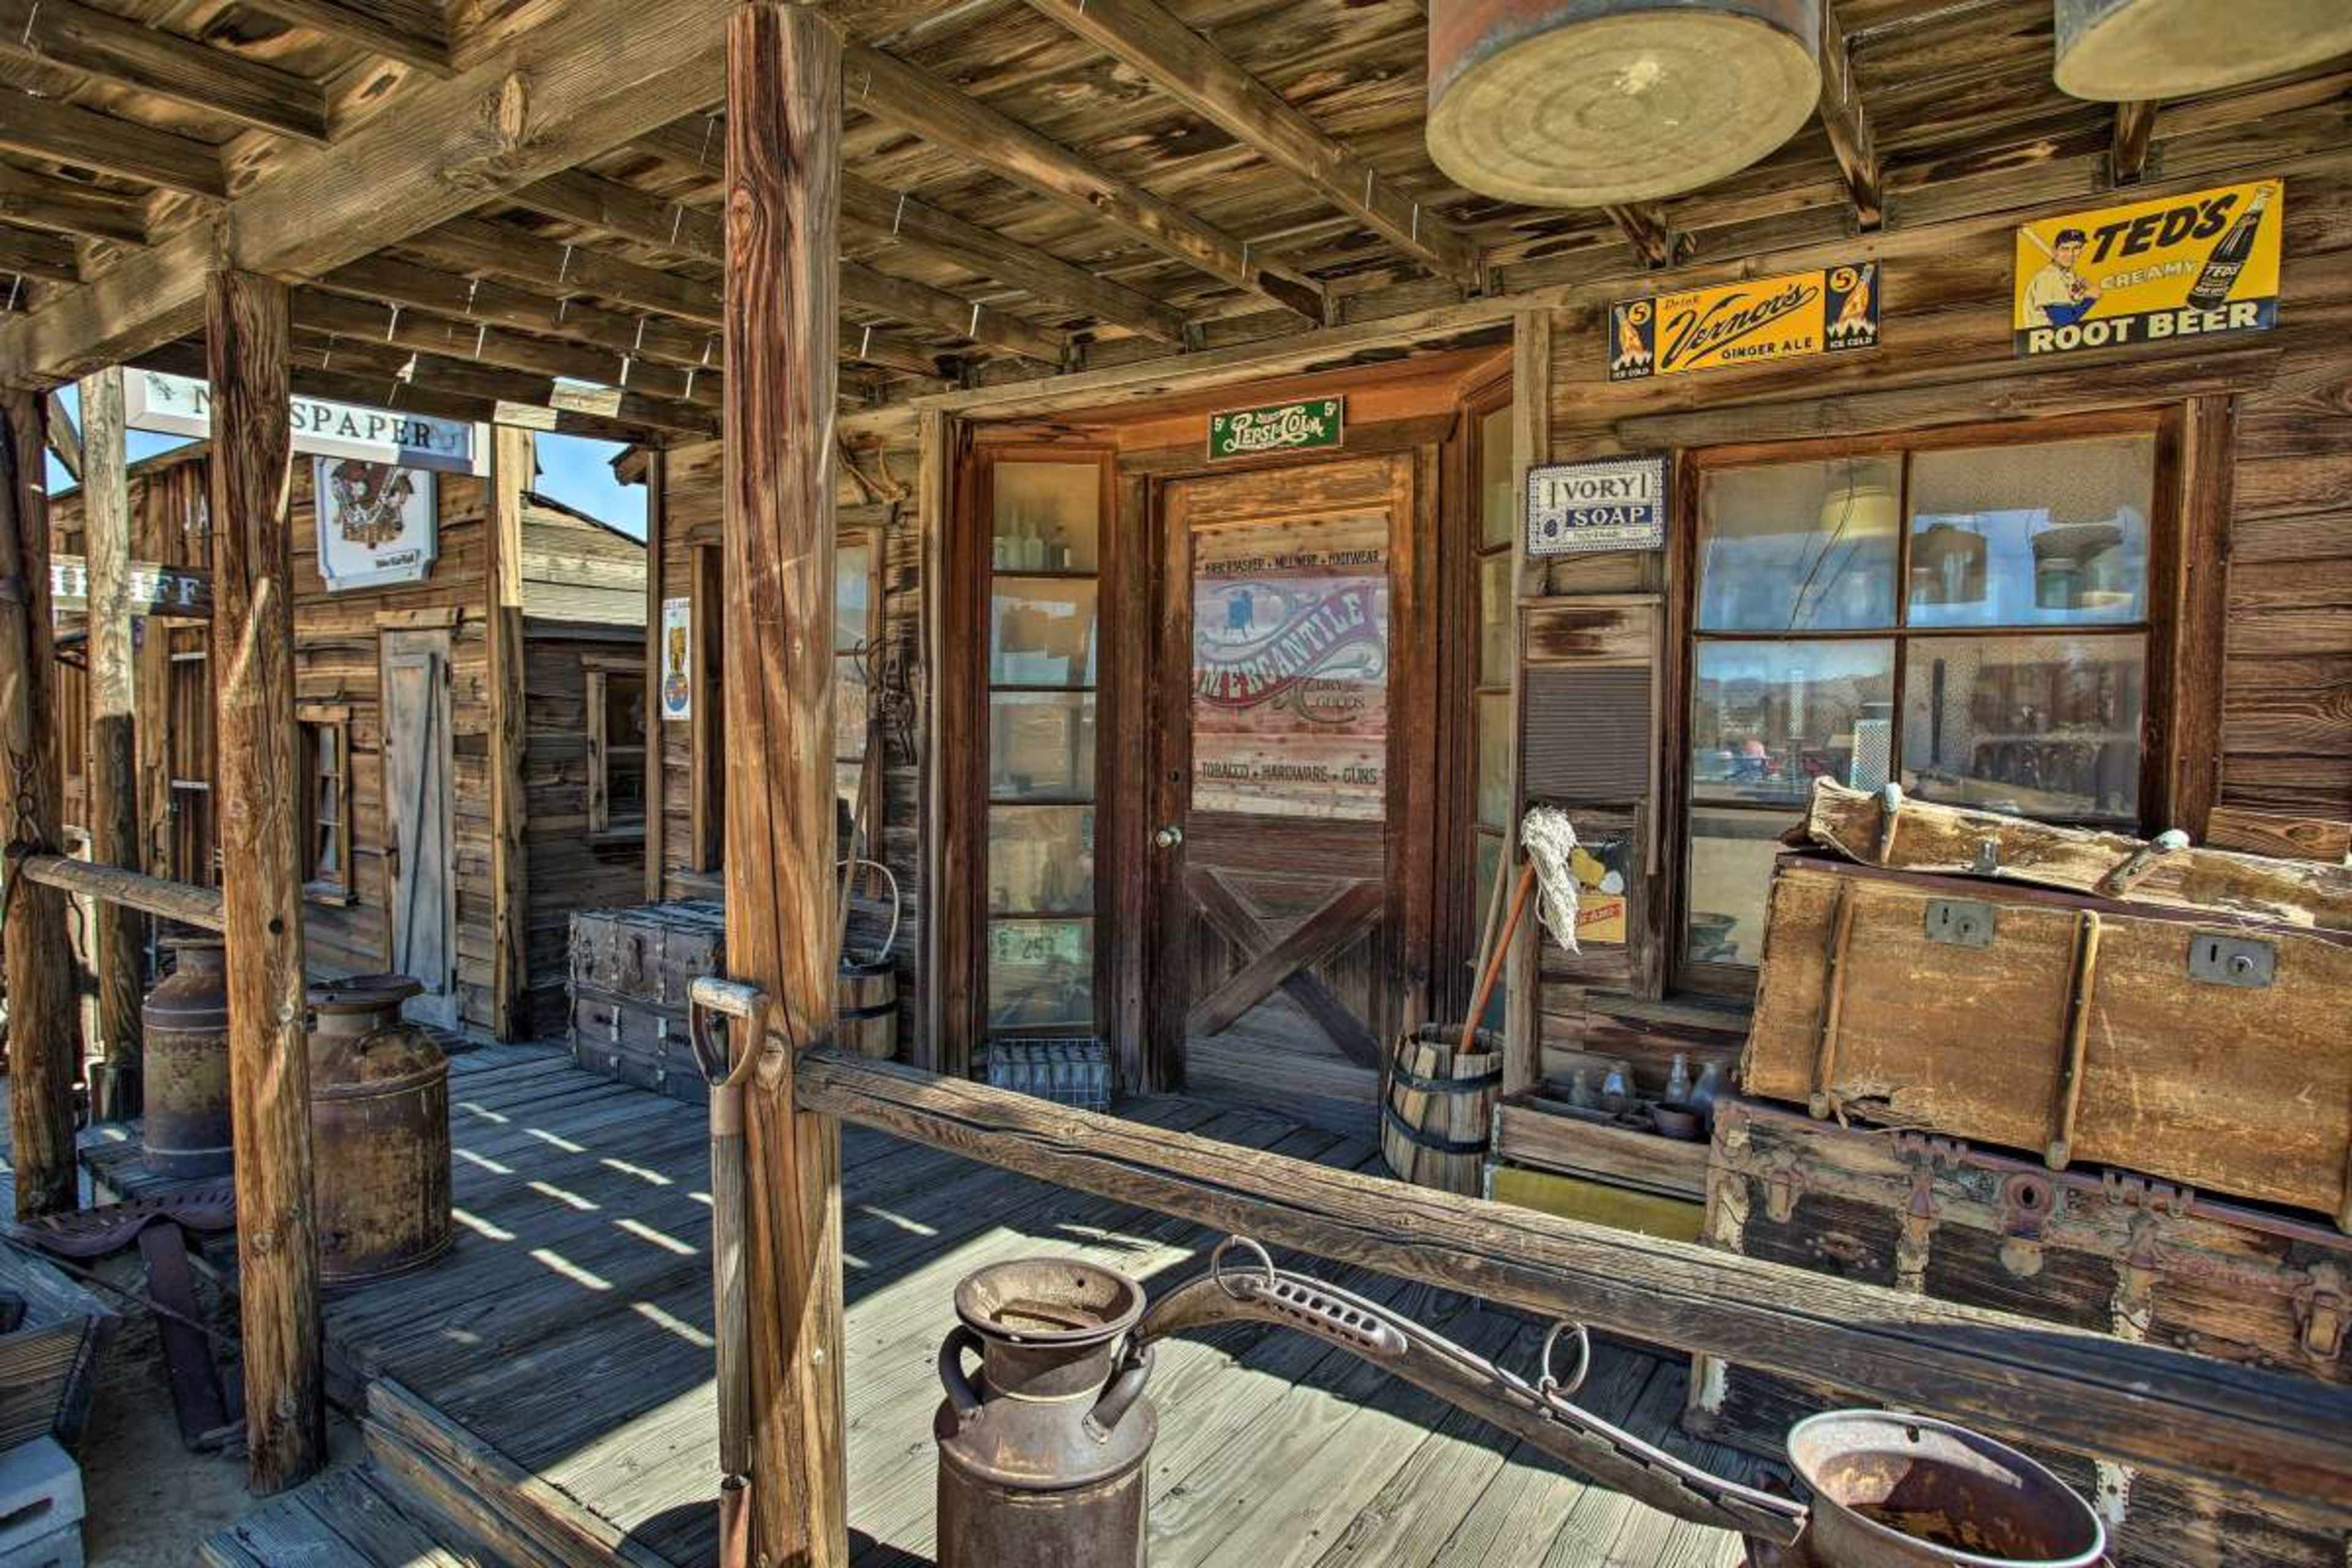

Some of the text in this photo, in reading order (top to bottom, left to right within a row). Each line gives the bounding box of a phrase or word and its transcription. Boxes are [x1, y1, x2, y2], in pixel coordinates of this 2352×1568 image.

[2091, 194, 2238, 263] TED'S
[2101, 260, 2195, 289] CREAMY
[2029, 302, 2258, 353] ROOT BEER
[1722, 338, 1812, 360] GINGER ALE
[1574, 508, 1645, 526] SOAP
[1198, 593, 1365, 699] MERCANTILE
[1202, 762, 1378, 785] TOBACCO HARDWARE GUNS
